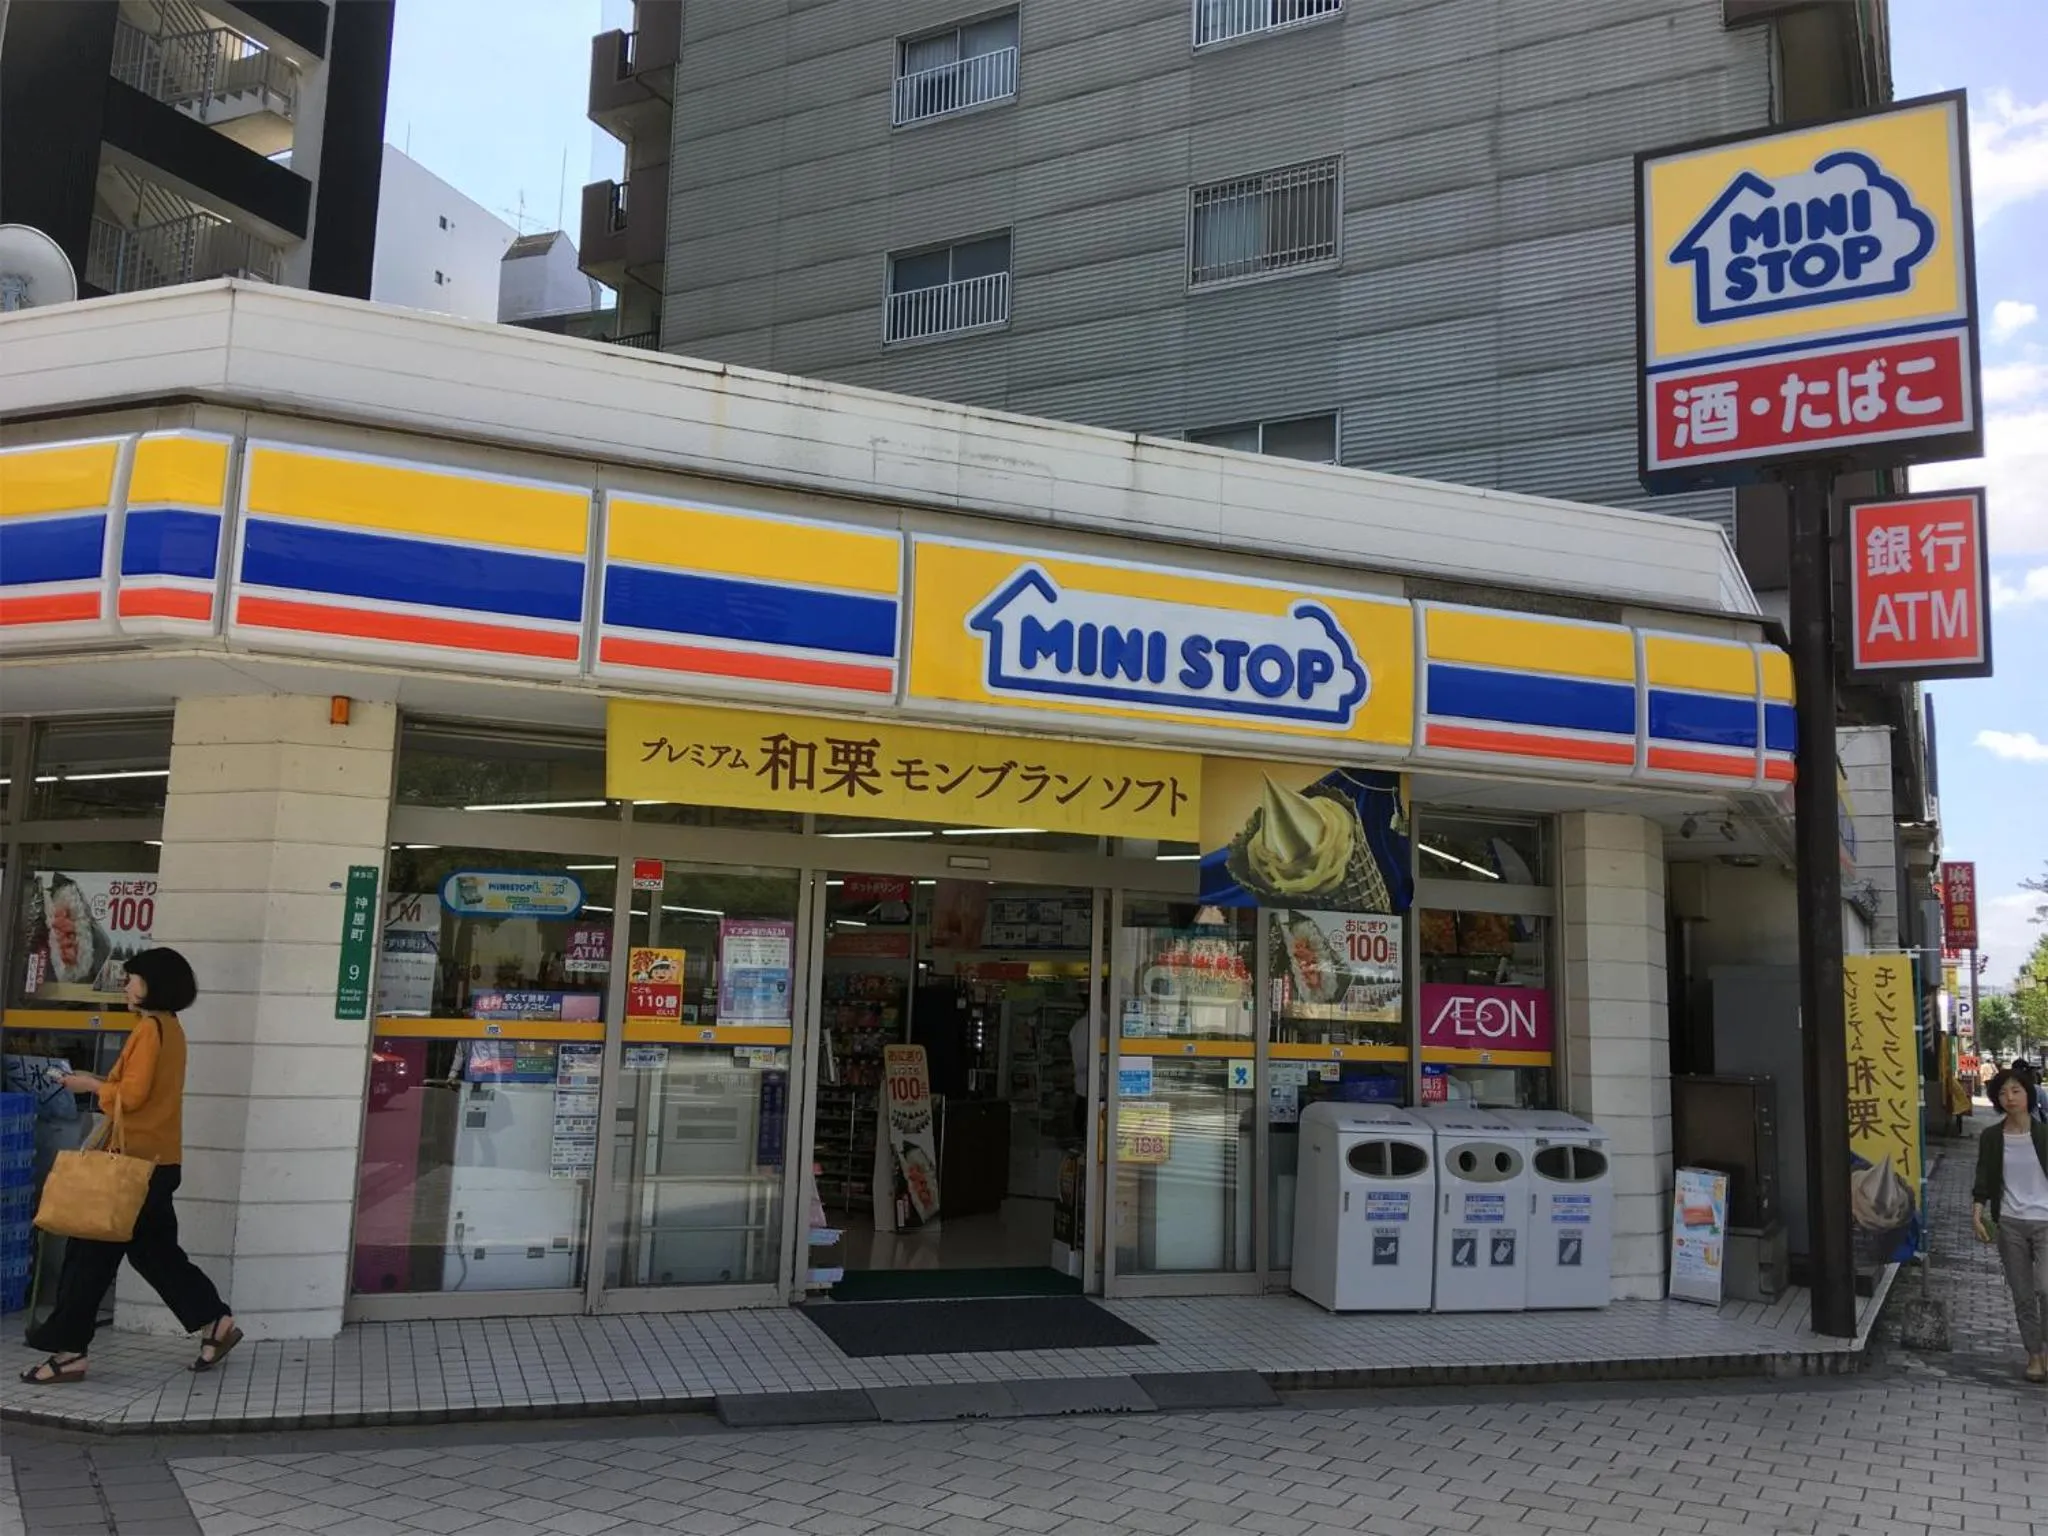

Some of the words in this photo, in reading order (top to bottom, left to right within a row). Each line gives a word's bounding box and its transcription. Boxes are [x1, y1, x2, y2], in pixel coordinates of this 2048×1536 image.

[1730, 189, 1871, 254] MINI
[1725, 236, 1882, 300] STOP
[1673, 357, 1944, 447] 酒・たばこ
[1866, 521, 1967, 577] 銀行
[1867, 588, 1968, 643] ATM
[1019, 614, 1167, 684] MINI
[1179, 634, 1334, 700] STOP
[109, 881, 158, 896] おにぎり
[108, 897, 154, 931] 100
[1344, 919, 1389, 934] おにぎり
[574, 931, 605, 945] 銀行
[1345, 935, 1388, 962] 100
[572, 946, 605, 959] ATM
[349, 965, 360, 980] 9
[1959, 1003, 1970, 1017] P
[888, 1078, 920, 1100] 100
